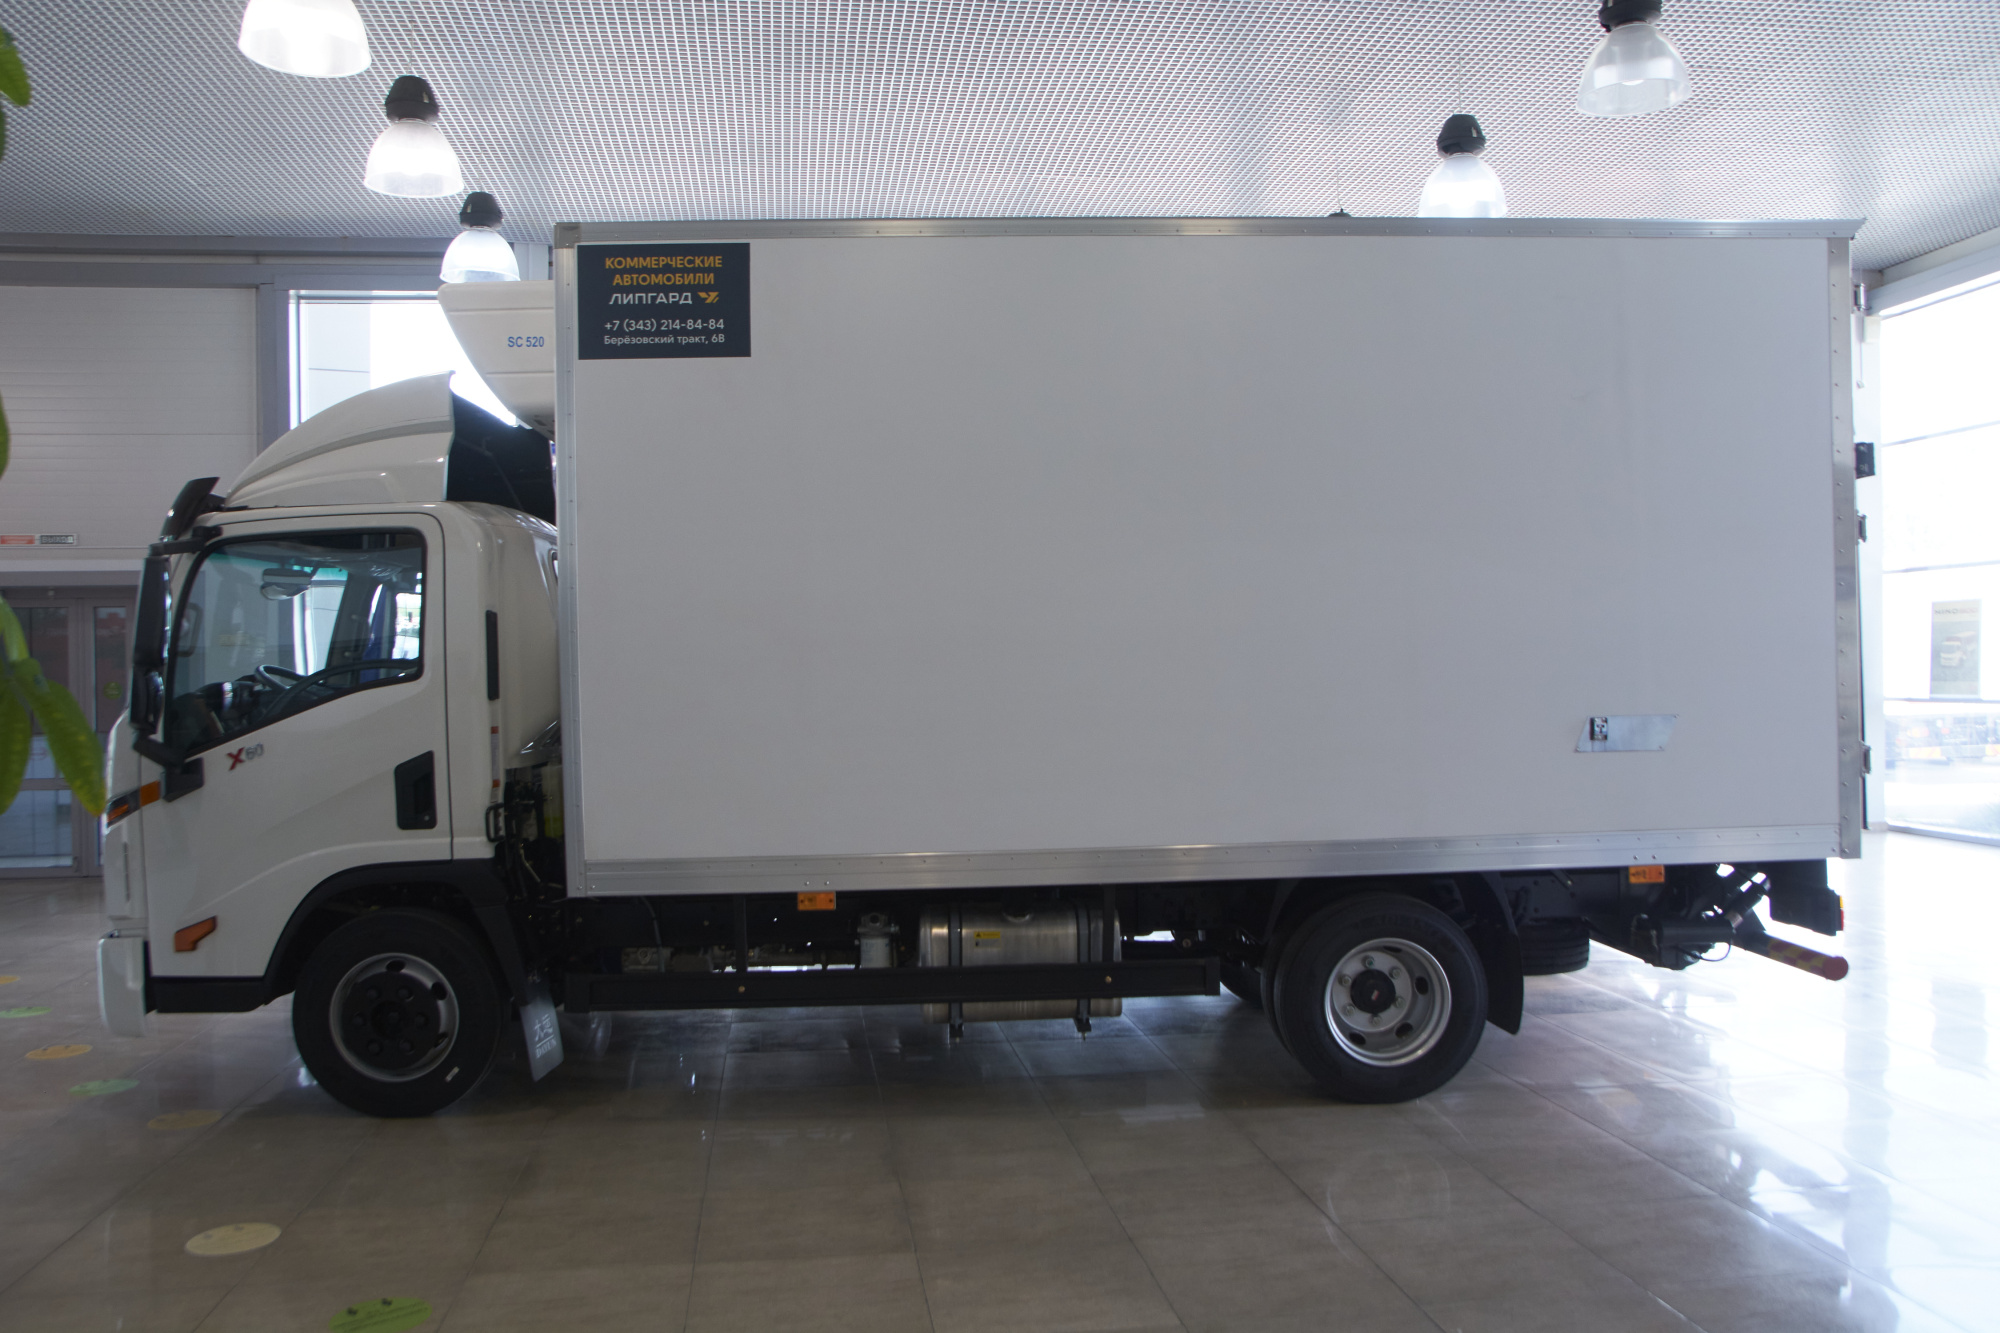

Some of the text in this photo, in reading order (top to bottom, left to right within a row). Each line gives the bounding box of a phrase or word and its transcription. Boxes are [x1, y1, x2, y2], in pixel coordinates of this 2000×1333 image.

[605, 256, 723, 269] КОММЕРЧЕСКИЕ
[612, 273, 715, 286] АВТОМОБИЛИ
[609, 292, 693, 305] ЛИПГАРД
[604, 318, 725, 332] +7 (343) 214-84-84
[507, 336, 545, 348] SC 520
[604, 334, 675, 346] Берёзовский
[677, 335, 709, 345] тракт,
